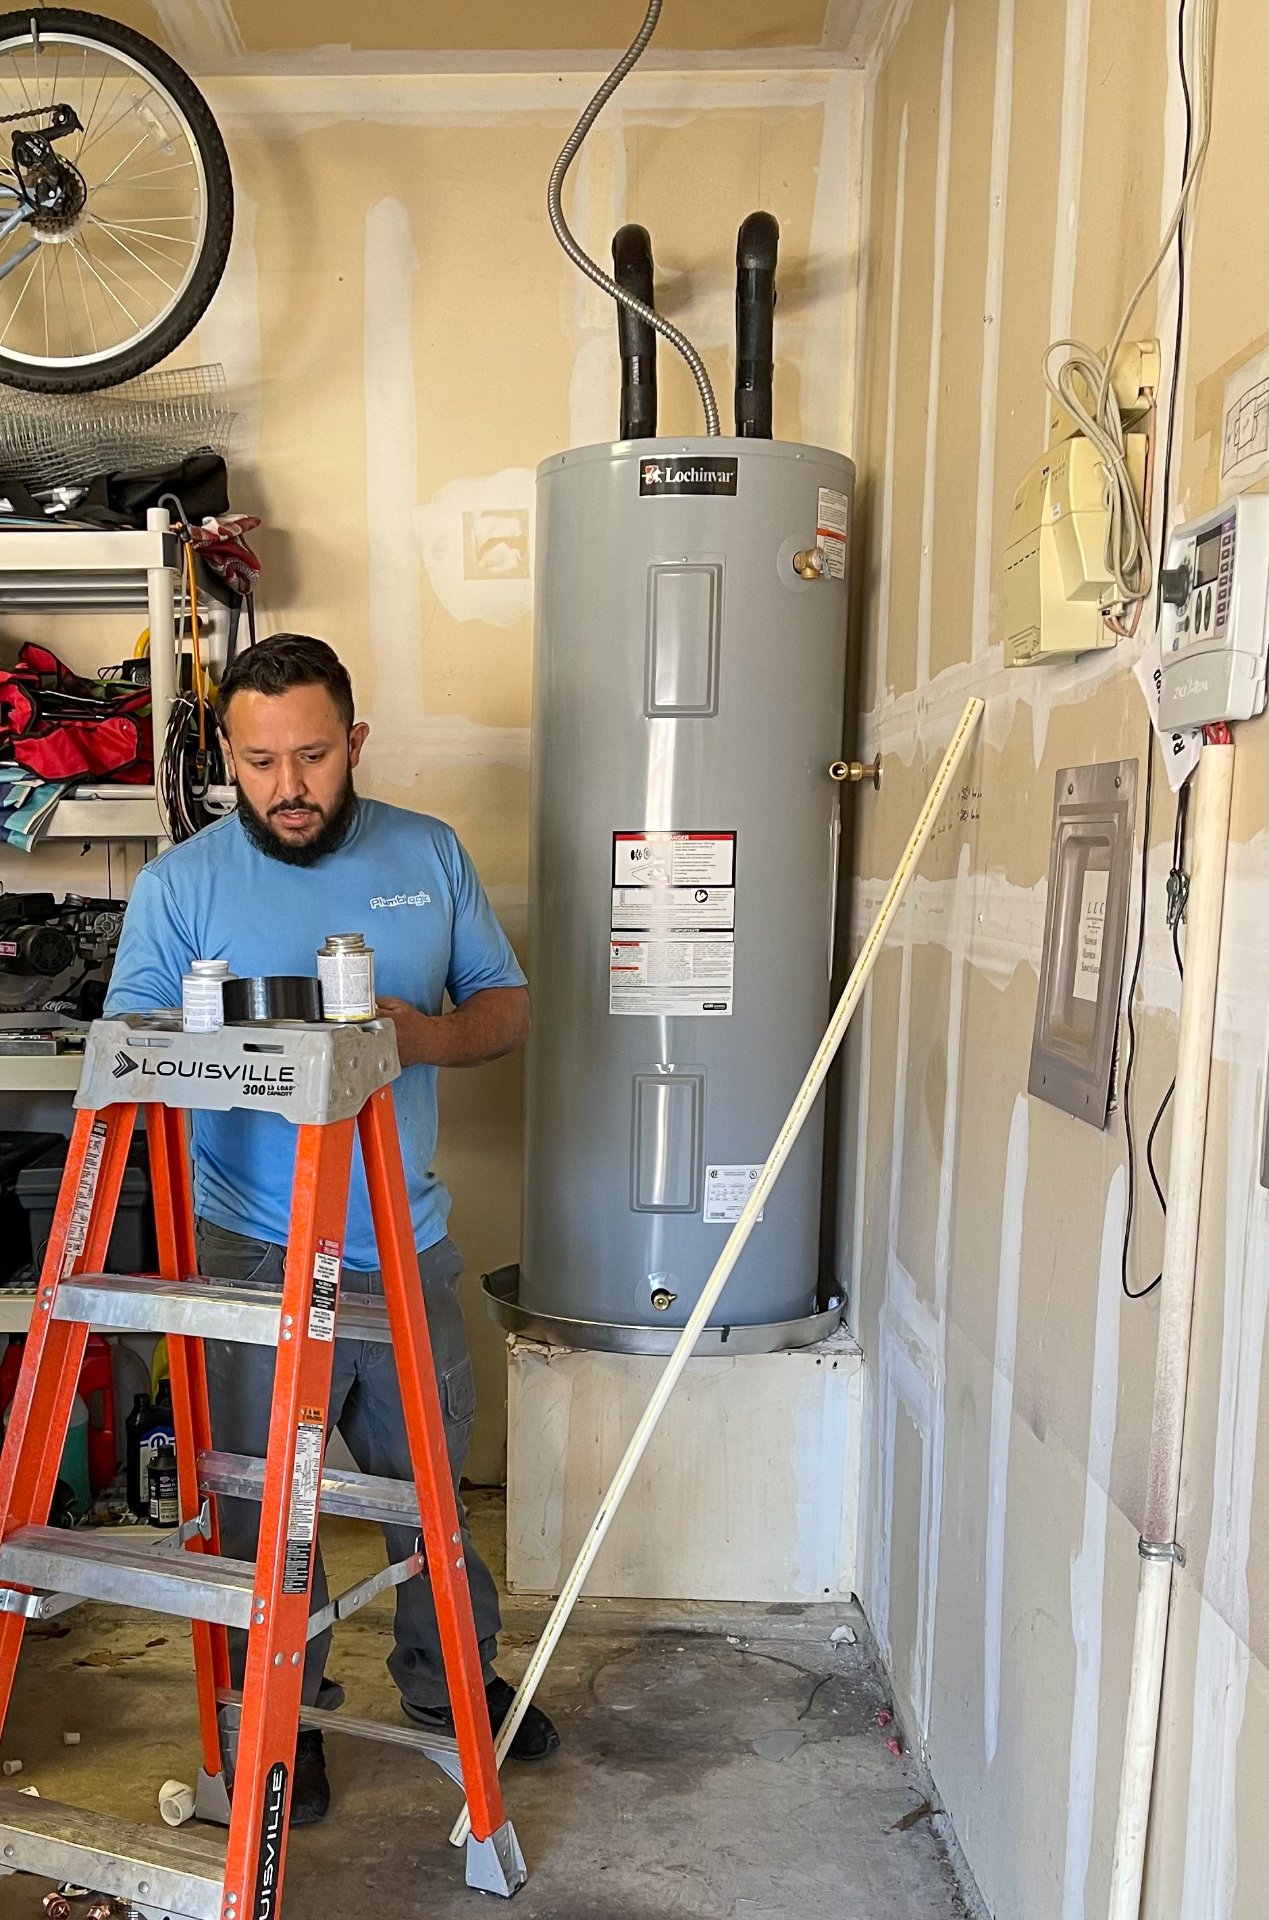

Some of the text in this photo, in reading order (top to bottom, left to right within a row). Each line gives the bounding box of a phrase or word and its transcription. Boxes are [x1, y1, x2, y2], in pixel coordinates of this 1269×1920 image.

[665, 467, 733, 482] Lochinvar
[142, 1058, 295, 1082] LOUISVILLE
[242, 1084, 266, 1095] 300
